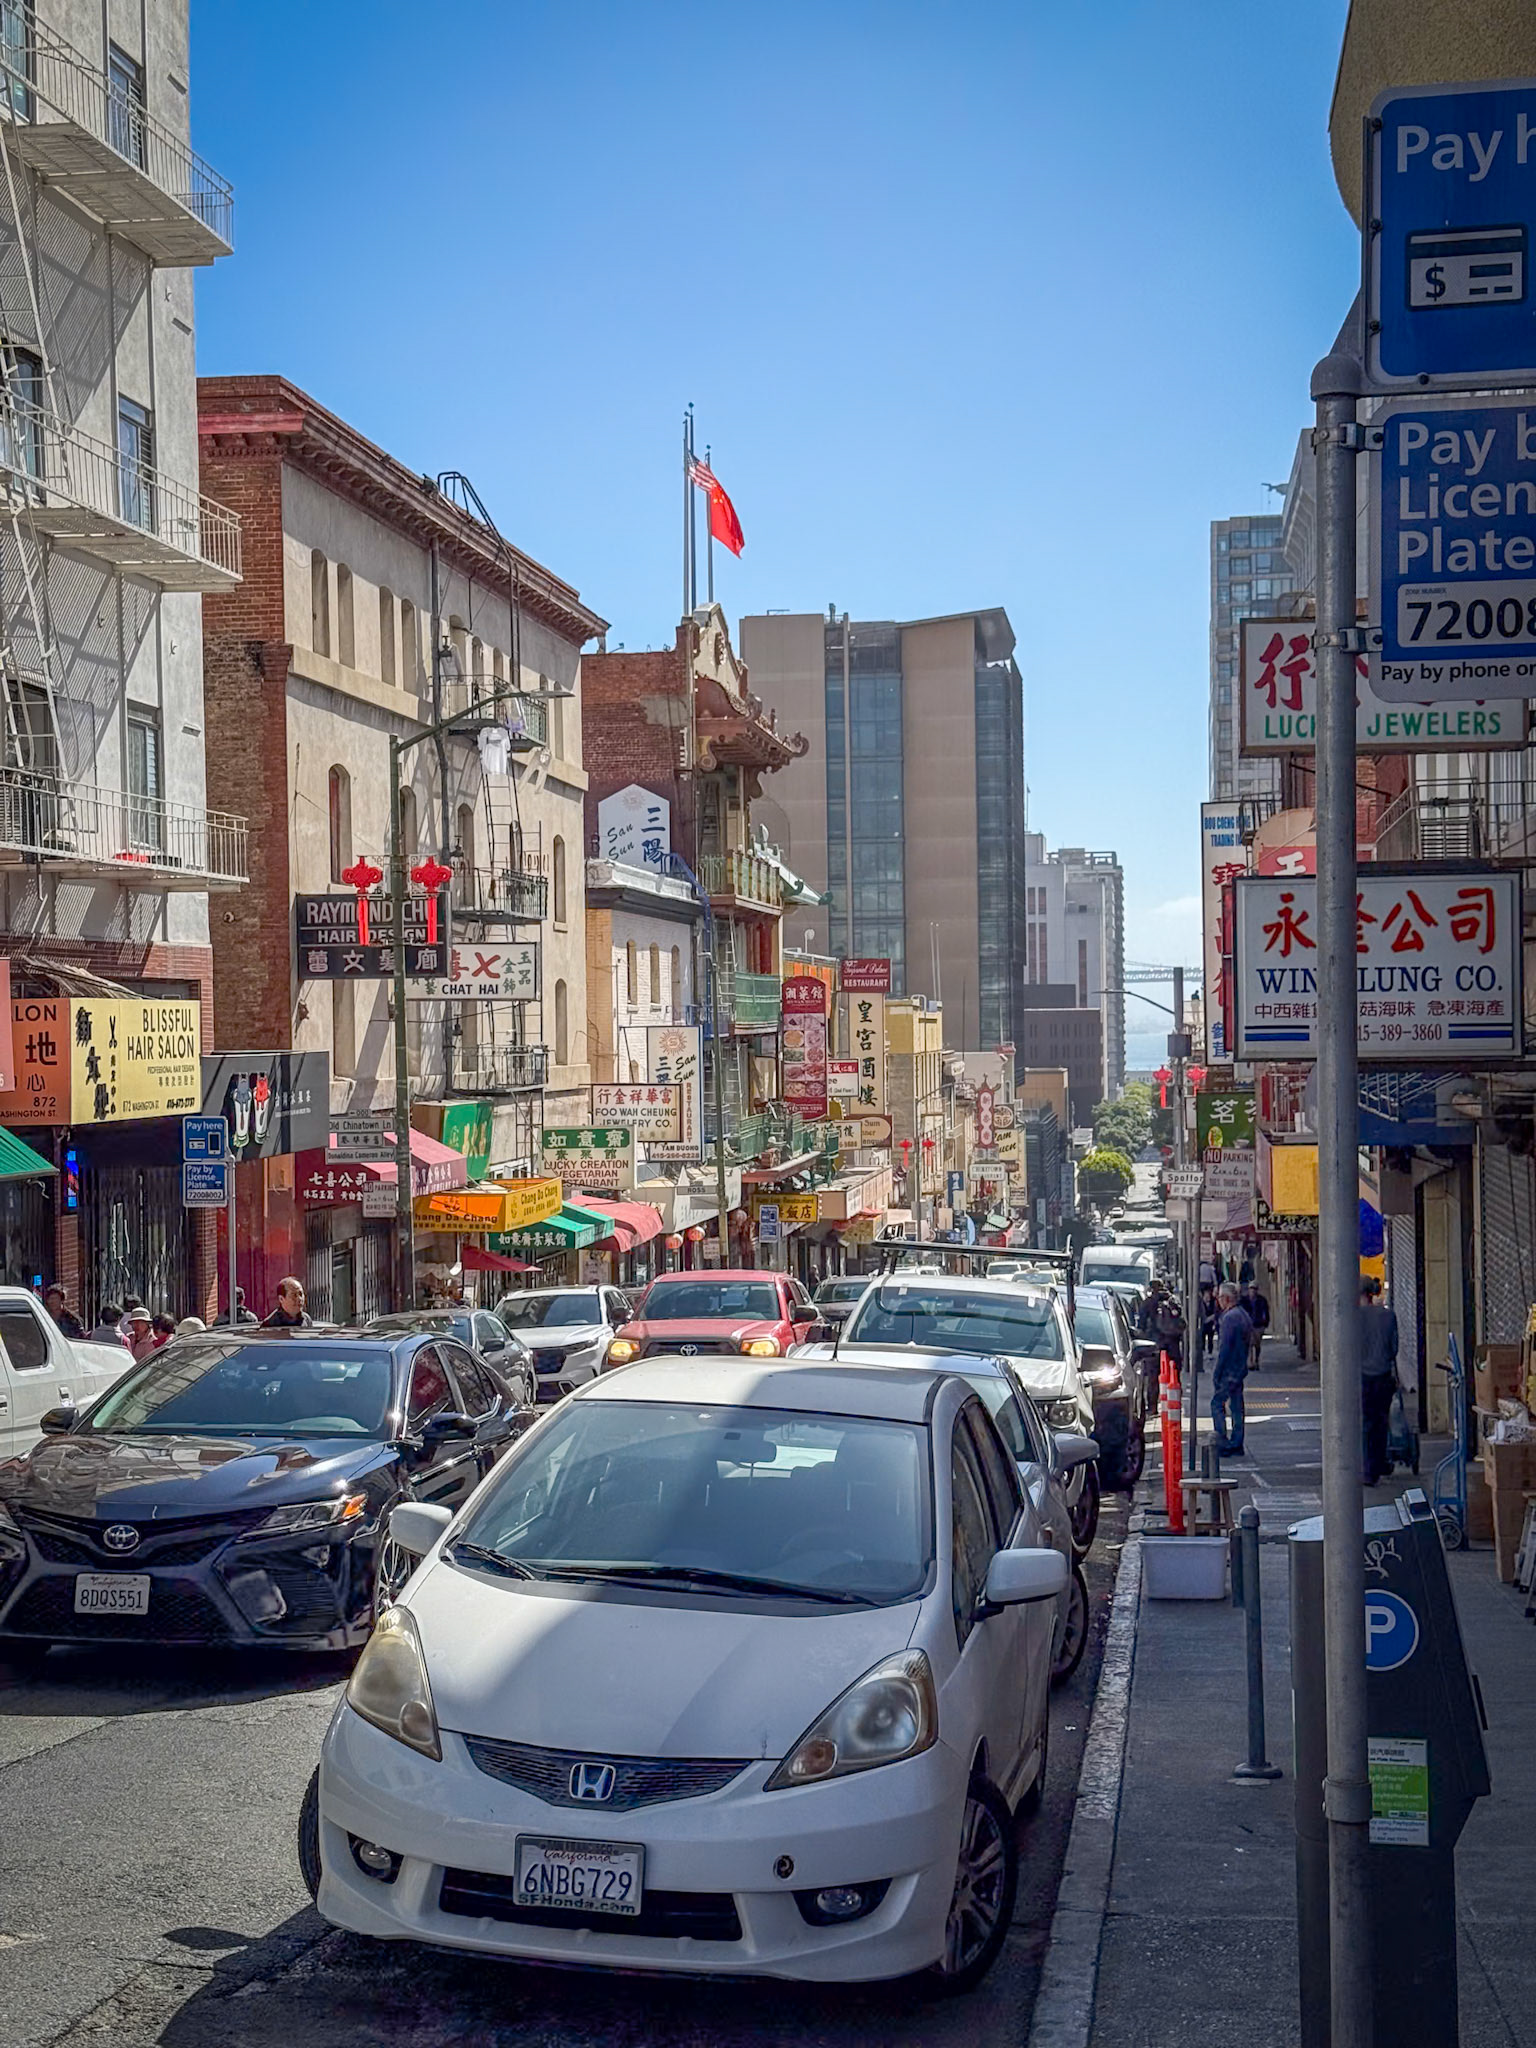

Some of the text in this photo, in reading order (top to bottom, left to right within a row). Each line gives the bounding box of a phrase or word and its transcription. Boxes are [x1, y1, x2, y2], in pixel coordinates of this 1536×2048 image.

[1397, 125, 1503, 182] Pay
[1398, 422, 1496, 476] Pay
[1400, 472, 1536, 519] Licen
[1400, 526, 1535, 574] Plate
[1381, 665, 1414, 683] Pay
[1420, 663, 1443, 682] by
[1450, 662, 1510, 682] phone
[1265, 711, 1500, 738] LUC JEWELERS
[306, 901, 393, 924] RAYMND
[318, 930, 426, 943] HAIR DESGN
[844, 979, 888, 987] RESTAURANT
[1256, 965, 1503, 993] WIN LUNG CO.
[441, 984, 499, 995] CHAT HAI
[143, 1008, 194, 1033] BLISSFUL
[1357, 1023, 1442, 1041] 15-389-3860
[25, 1031, 57, 1066] 地
[127, 1035, 194, 1061] HAIR SALON
[33, 1097, 56, 1107] 872
[595, 1106, 677, 1117] FOO WAH CHEUNG
[186, 1121, 223, 1132] Pay here
[343, 1120, 380, 1131] Chinatown
[382, 1120, 391, 1130] Ln
[655, 1118, 673, 1128] CO.
[1206, 1149, 1254, 1163] NO PARKING
[544, 1160, 629, 1169] LUCKY CREATION
[187, 1174, 216, 1182] License
[187, 1181, 207, 1189] Plate
[562, 1178, 620, 1187] ESTAURANT
[520, 1192, 536, 1205] Chang
[415, 1213, 498, 1224] hang Da Chang
[524, 1863, 632, 1901] 6NBG729
[518, 1893, 636, 1915] SFHonda.com
